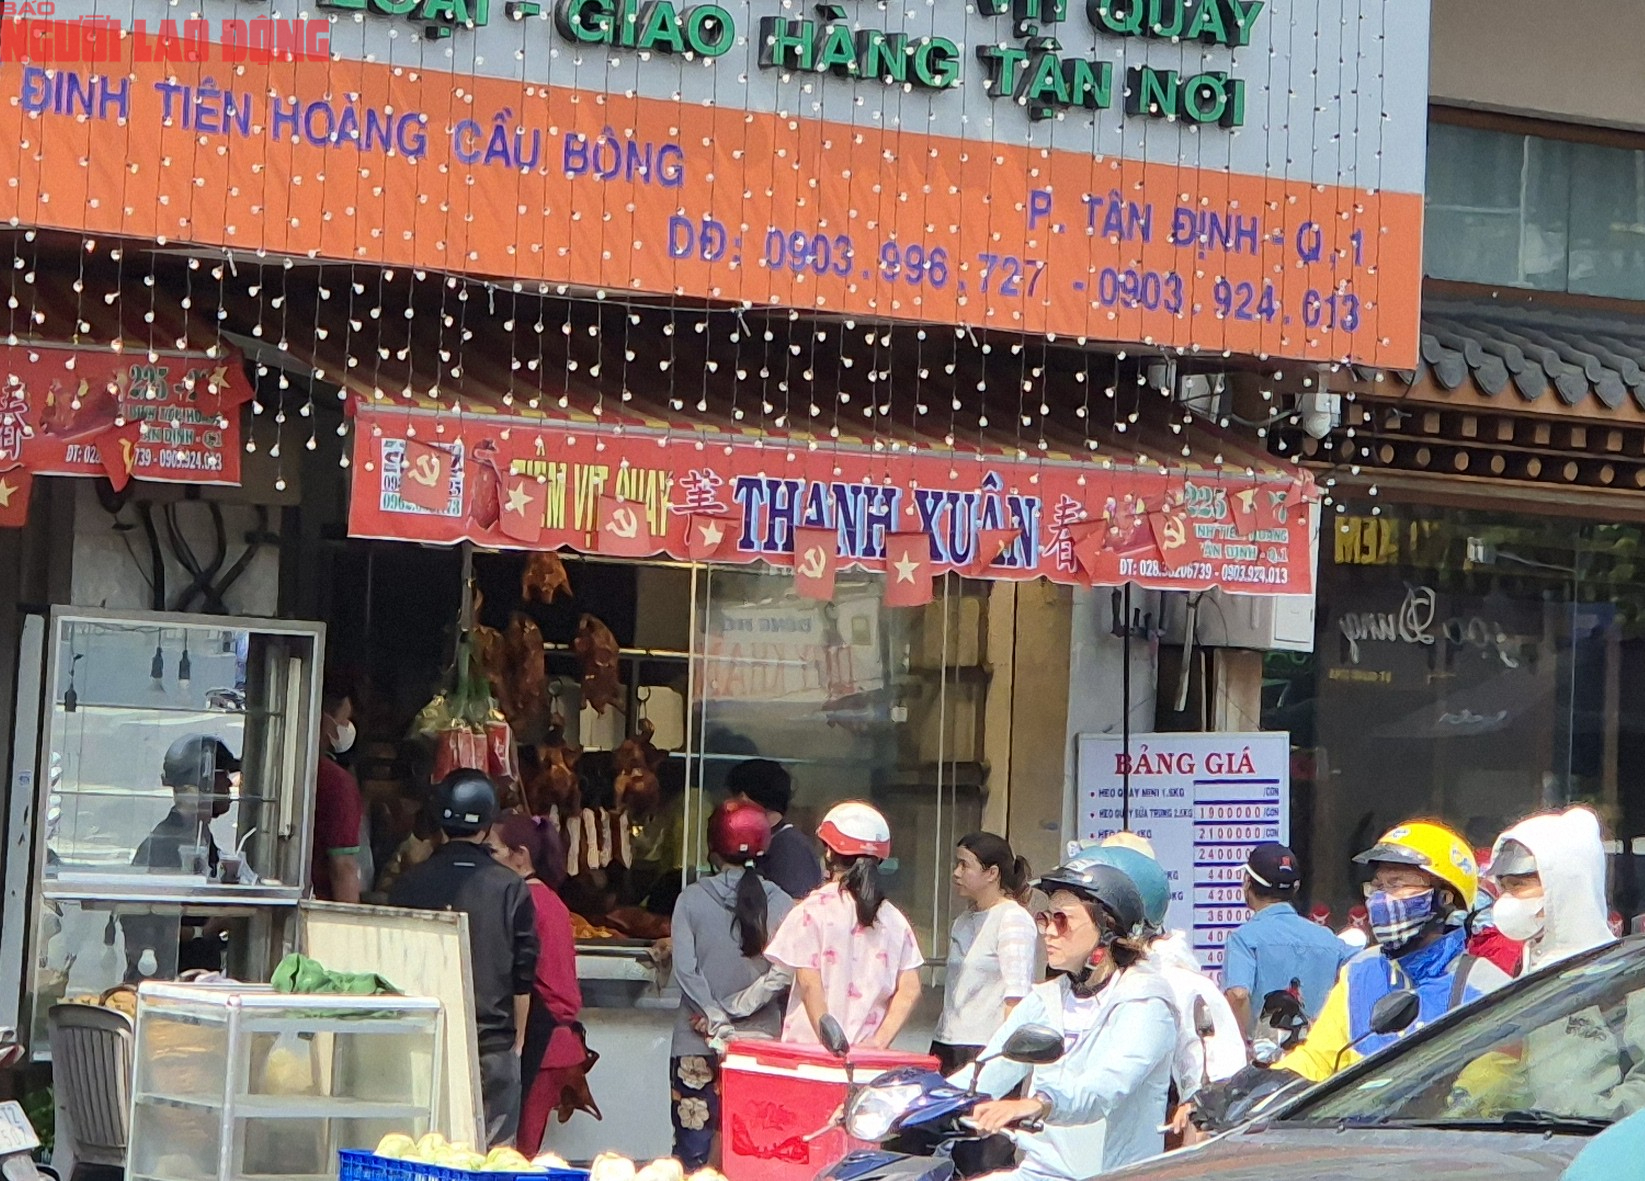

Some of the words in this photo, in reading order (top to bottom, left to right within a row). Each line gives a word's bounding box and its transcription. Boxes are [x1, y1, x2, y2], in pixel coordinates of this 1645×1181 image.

[556, 0, 735, 57] GIAO
[760, 5, 960, 88] HÀNG
[976, 37, 1113, 120] TẬN
[1126, 66, 1245, 127] NƠI
[21, 65, 129, 120] ĐINH
[153, 75, 250, 138] TIÊN
[272, 92, 427, 158] HOÀNG
[452, 106, 541, 169] CẦU
[562, 124, 685, 189] BÔNG
[1082, 188, 1152, 242] TÂN
[1172, 207, 1258, 260] ĐỊNH
[732, 475, 902, 560] THANH
[912, 470, 1043, 570] XUÂN
[1114, 744, 1196, 775] BẢNG
[1204, 745, 1257, 775] GIÁ
[1117, 787, 1140, 797] QAY
[1115, 808, 1134, 818] QUY
